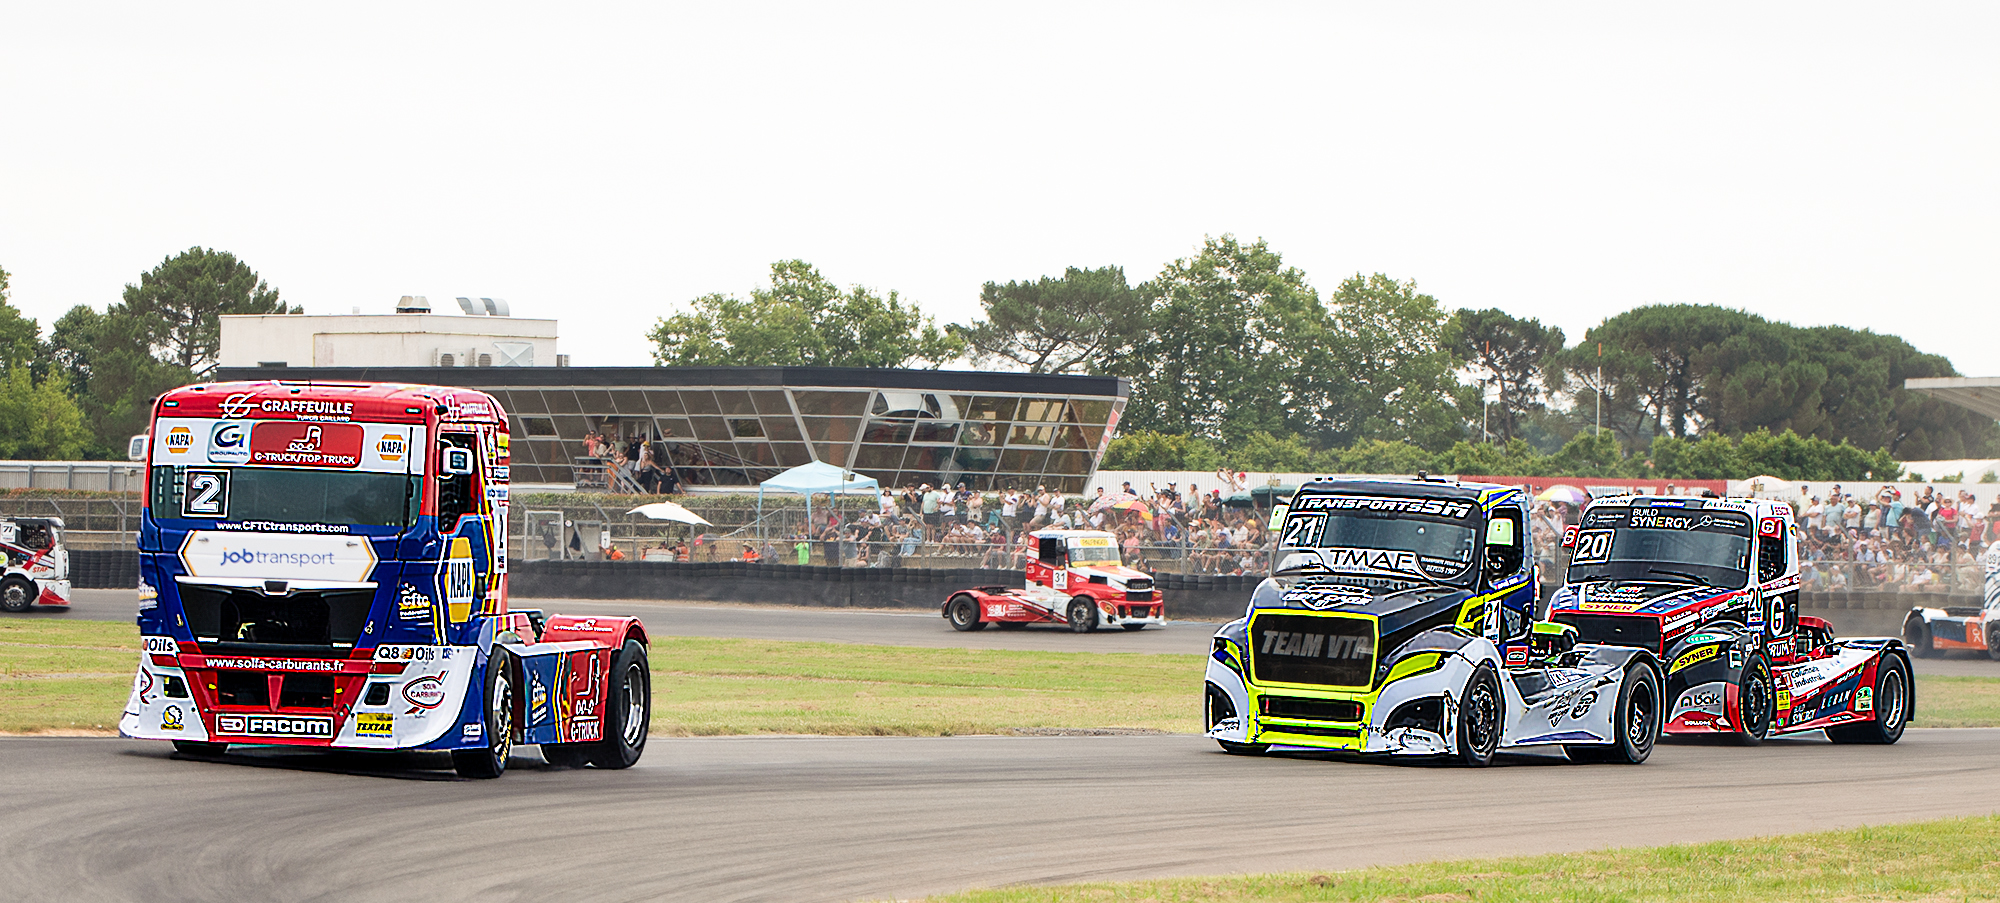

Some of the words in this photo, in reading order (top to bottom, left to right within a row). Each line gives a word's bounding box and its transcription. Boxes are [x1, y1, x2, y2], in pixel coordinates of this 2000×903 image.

[261, 400, 354, 415] GRAFFEUILLE
[169, 434, 190, 446] NAPA
[380, 440, 403, 454] NAPA
[254, 452, 321, 463] G-TRUCK/TOP
[322, 456, 355, 465] TRUCK
[191, 474, 220, 512] 2
[1633, 508, 1659, 517] BUILD
[216, 521, 349, 533] www.CFTCtransports.com
[1283, 518, 1319, 545] 21
[1576, 534, 1608, 559] 20
[450, 563, 471, 598] NAPA
[1055, 573, 1065, 583] 31
[148, 638, 174, 652] Oils
[1261, 630, 1323, 658] TEAM
[378, 647, 400, 660] Q8
[416, 647, 435, 661] Oils
[1679, 648, 1714, 667] SYNER
[250, 719, 329, 733] FACOM
[356, 722, 393, 732] TEXTAR
[571, 721, 600, 741] G-TRUCK
